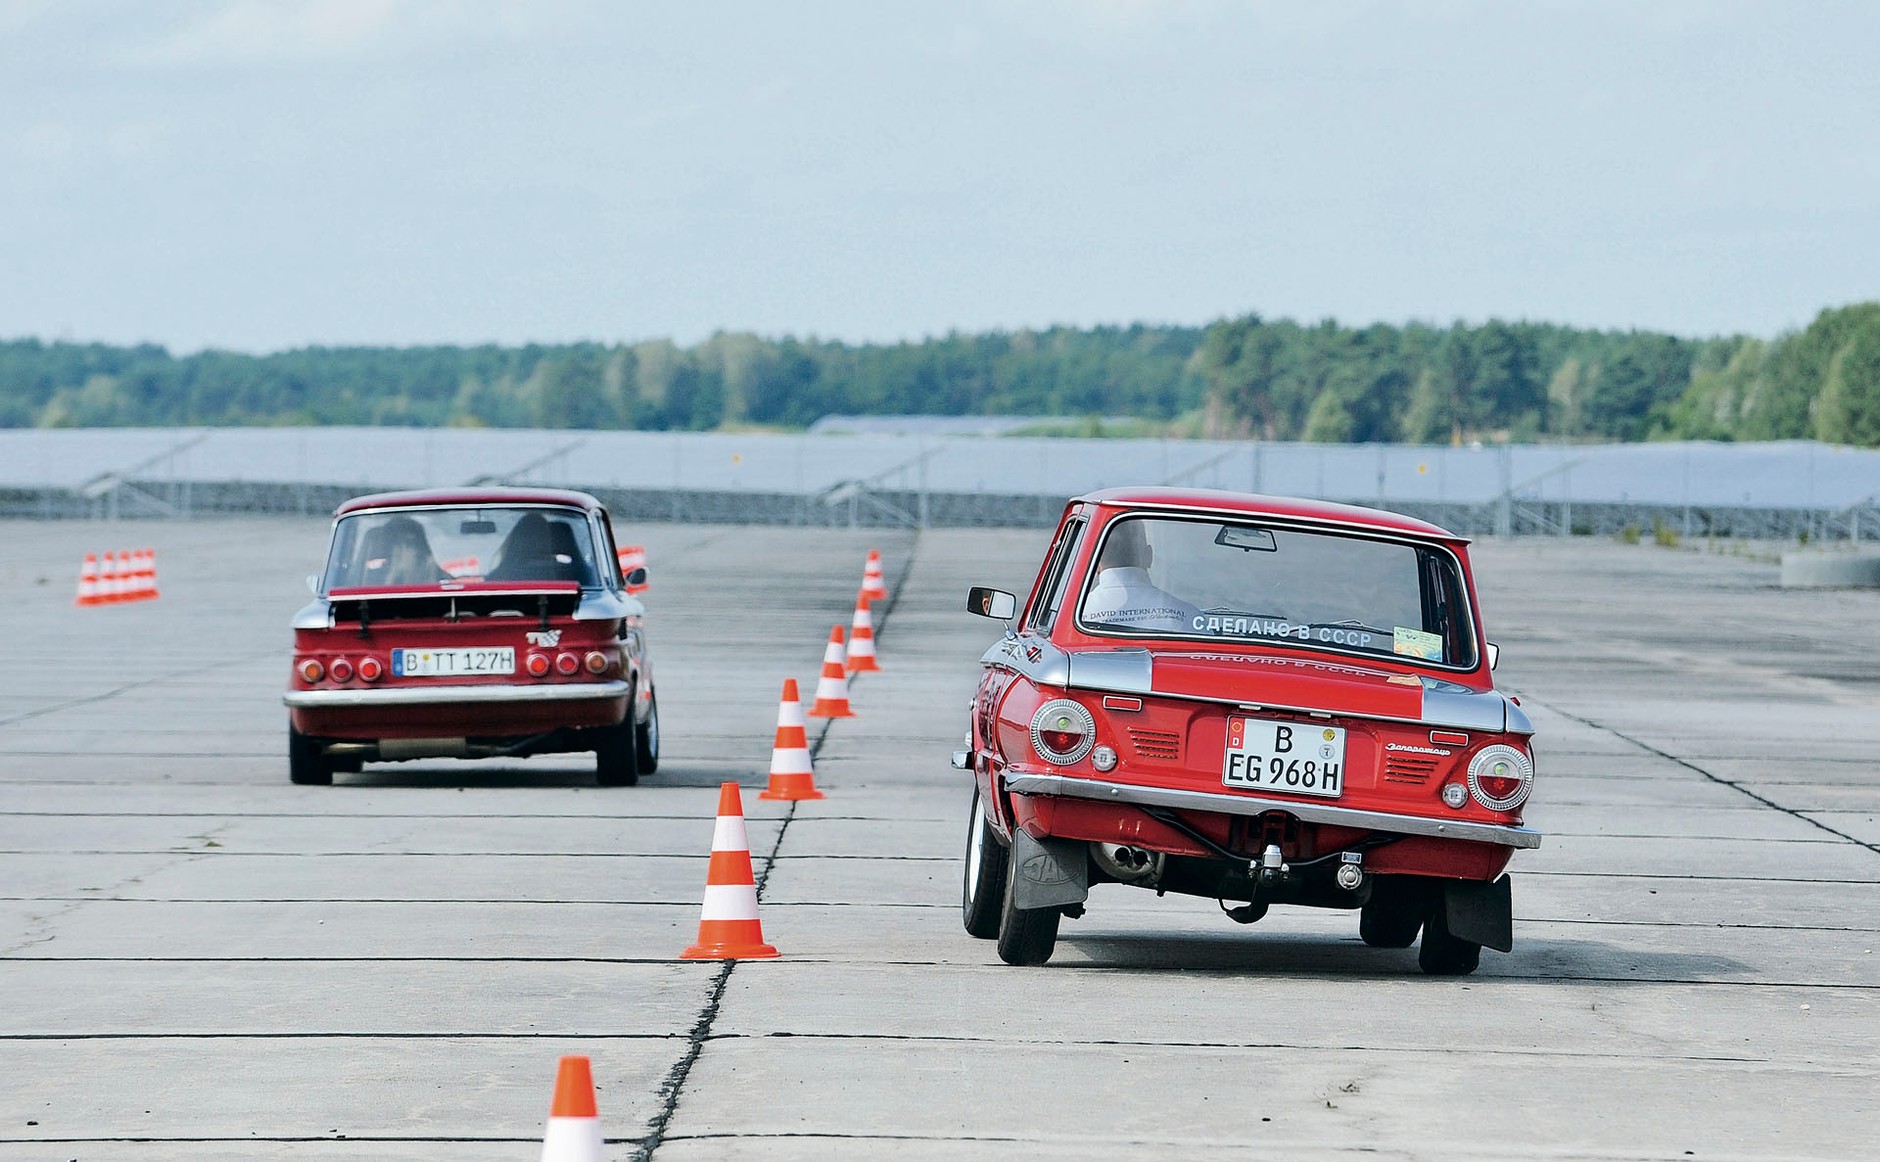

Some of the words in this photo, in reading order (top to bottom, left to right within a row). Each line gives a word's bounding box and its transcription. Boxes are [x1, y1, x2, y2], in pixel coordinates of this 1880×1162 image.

[1090, 610, 1116, 620] DAVID
[1119, 607, 1187, 618] INTERNATIONAL
[1192, 616, 1290, 637] СДЕЛАНО
[1298, 625, 1310, 640] В
[1319, 627, 1372, 647] СССР
[406, 654, 418, 672] B
[433, 653, 457, 671] TT
[464, 652, 512, 670] 127H
[1232, 737, 1240, 746] D
[1275, 725, 1293, 753] B
[1228, 753, 1262, 782] EG
